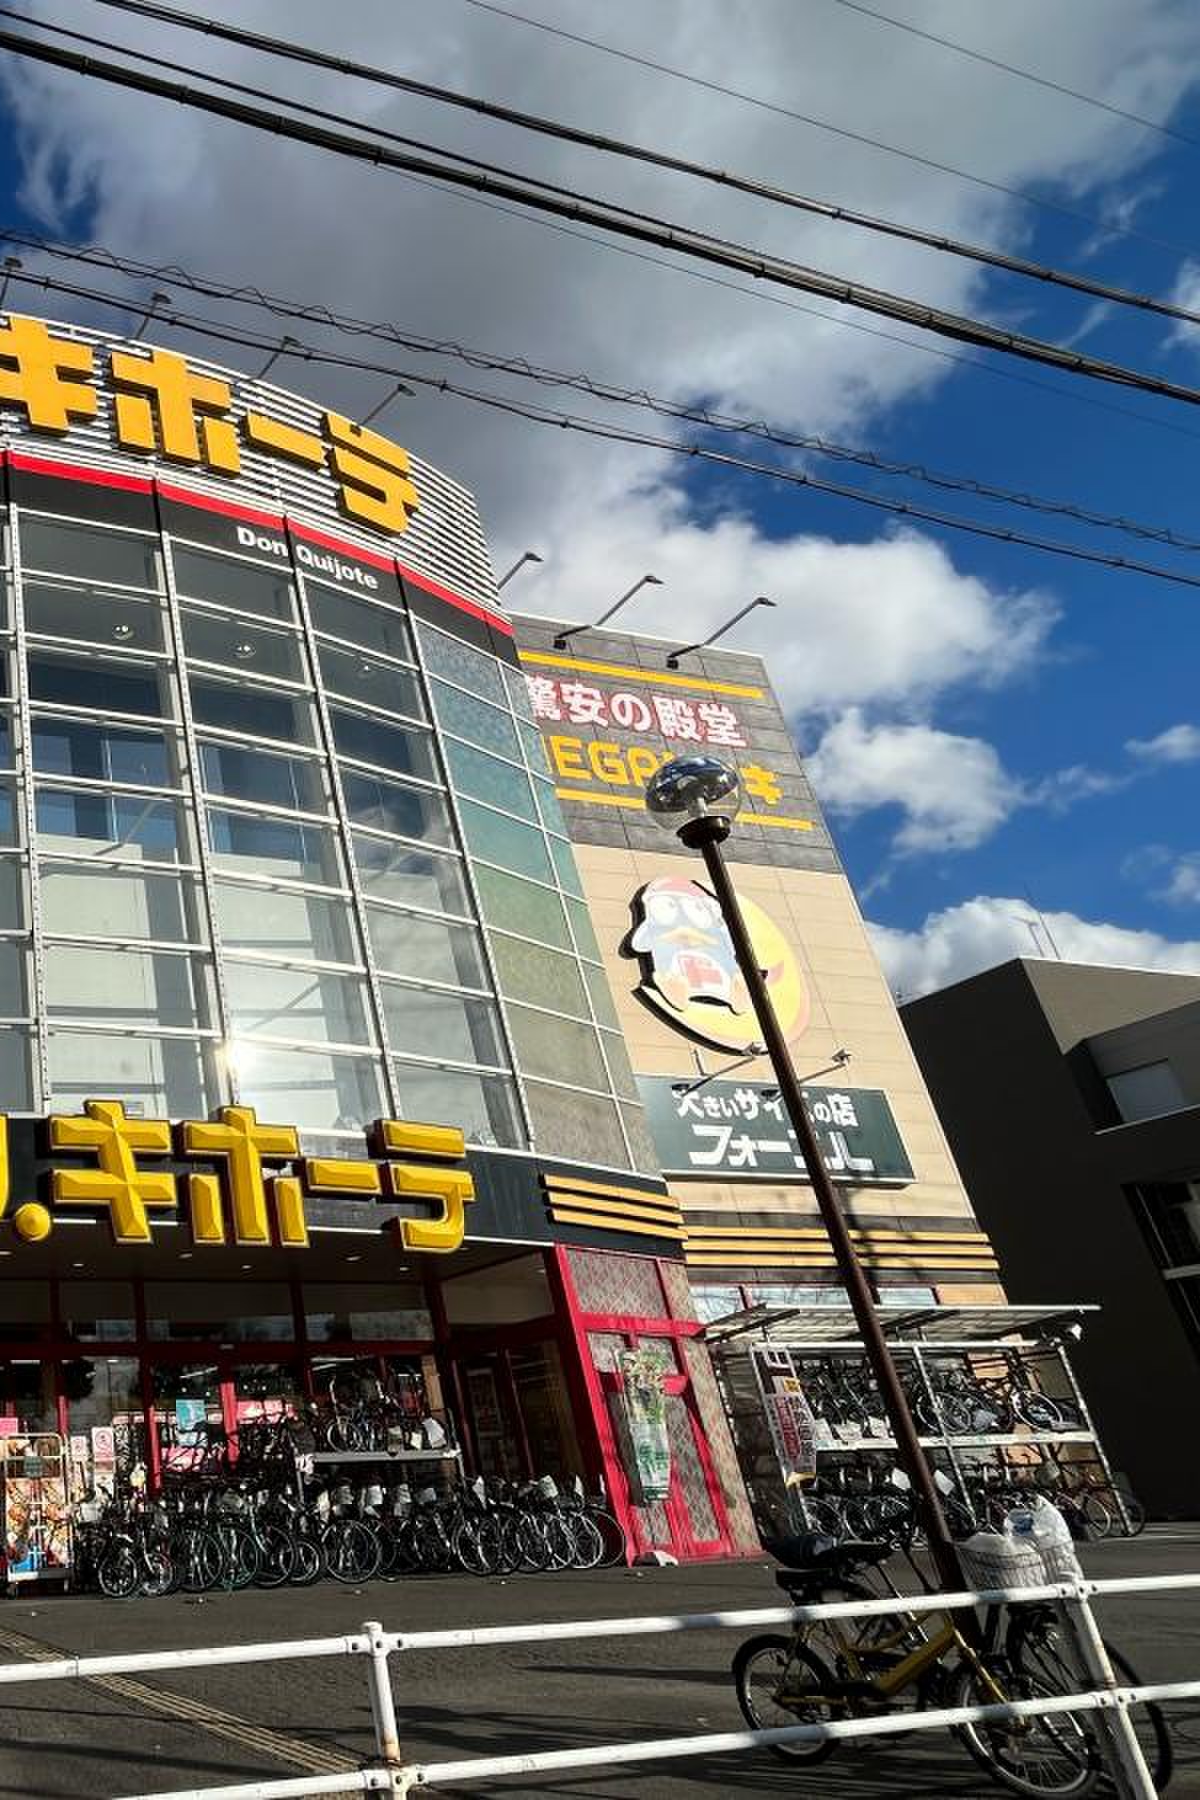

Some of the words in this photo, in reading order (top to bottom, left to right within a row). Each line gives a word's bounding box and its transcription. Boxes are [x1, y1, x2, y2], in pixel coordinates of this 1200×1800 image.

[236, 525, 289, 558] Don
[295, 544, 379, 589] Quijote
[671, 1087, 859, 1128] 大きいサイの店
